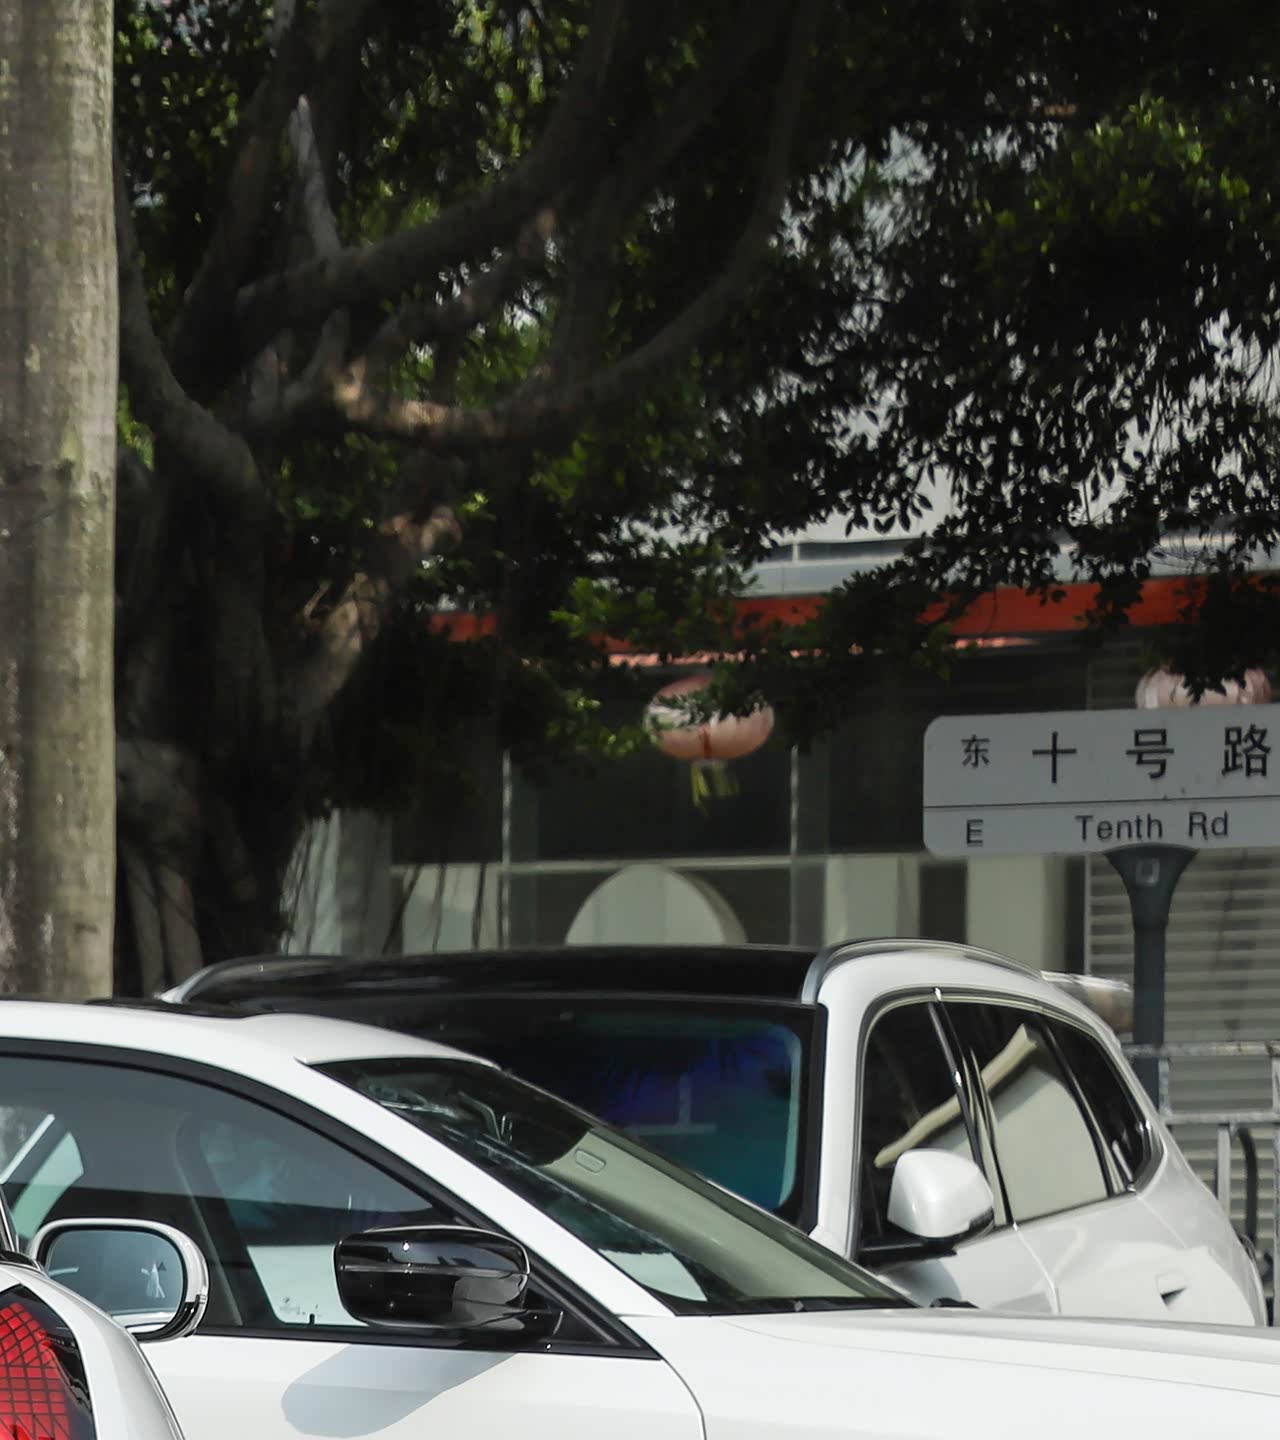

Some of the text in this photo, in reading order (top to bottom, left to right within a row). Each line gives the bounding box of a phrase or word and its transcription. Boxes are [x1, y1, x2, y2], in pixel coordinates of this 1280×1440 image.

[961, 723, 1271, 785] 东 十号路
[965, 811, 1229, 845] E Tenth Rd
